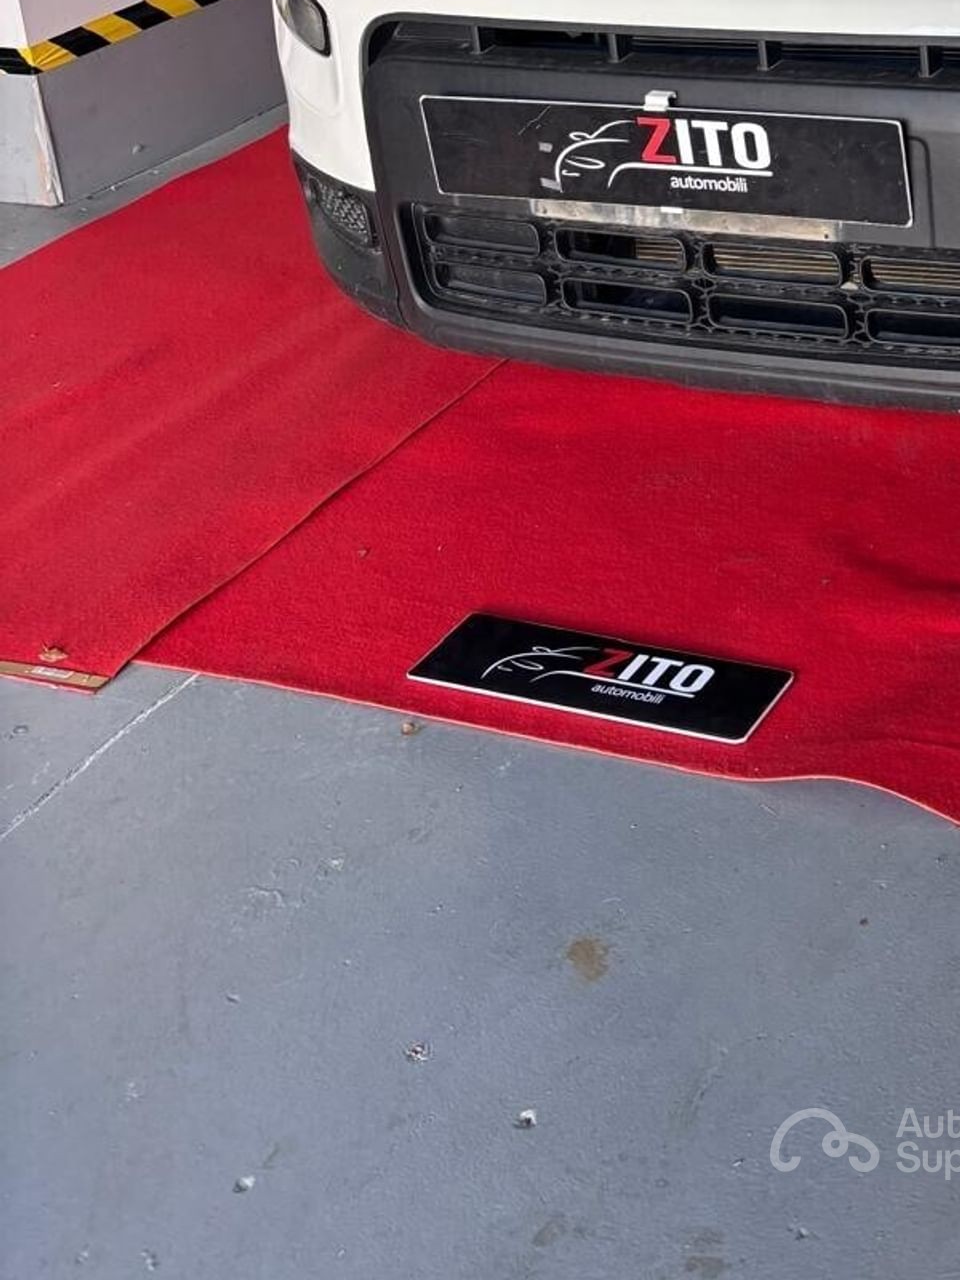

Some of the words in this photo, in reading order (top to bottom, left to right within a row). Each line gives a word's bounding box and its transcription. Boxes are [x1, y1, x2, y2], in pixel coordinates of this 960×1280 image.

[637, 116, 771, 170] ZITO
[670, 175, 748, 193] automobili
[584, 647, 715, 693] ZITO
[590, 684, 667, 705] automobili
